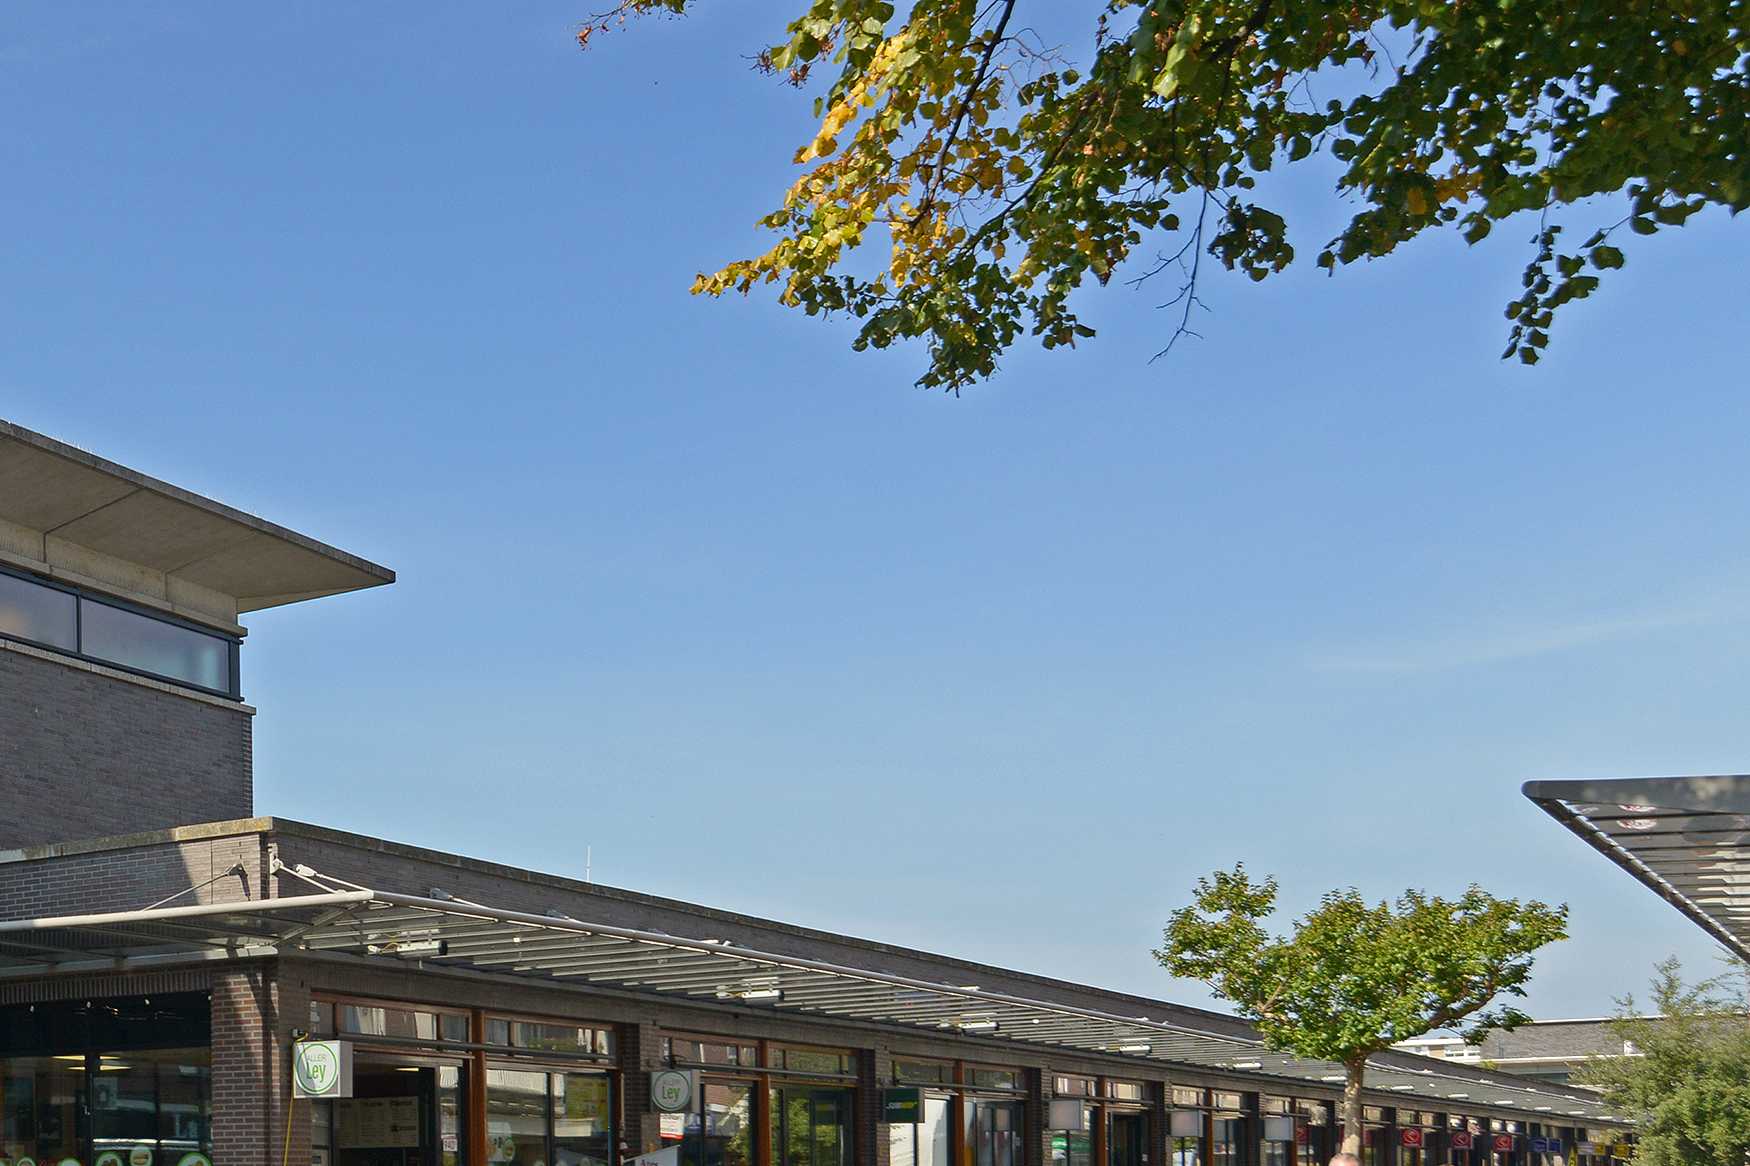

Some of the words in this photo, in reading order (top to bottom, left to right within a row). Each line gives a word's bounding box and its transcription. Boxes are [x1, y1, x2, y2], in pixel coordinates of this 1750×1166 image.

[307, 1054, 327, 1062] ALLER
[307, 1061, 327, 1084] Ley
[661, 1085, 681, 1102] Ley
